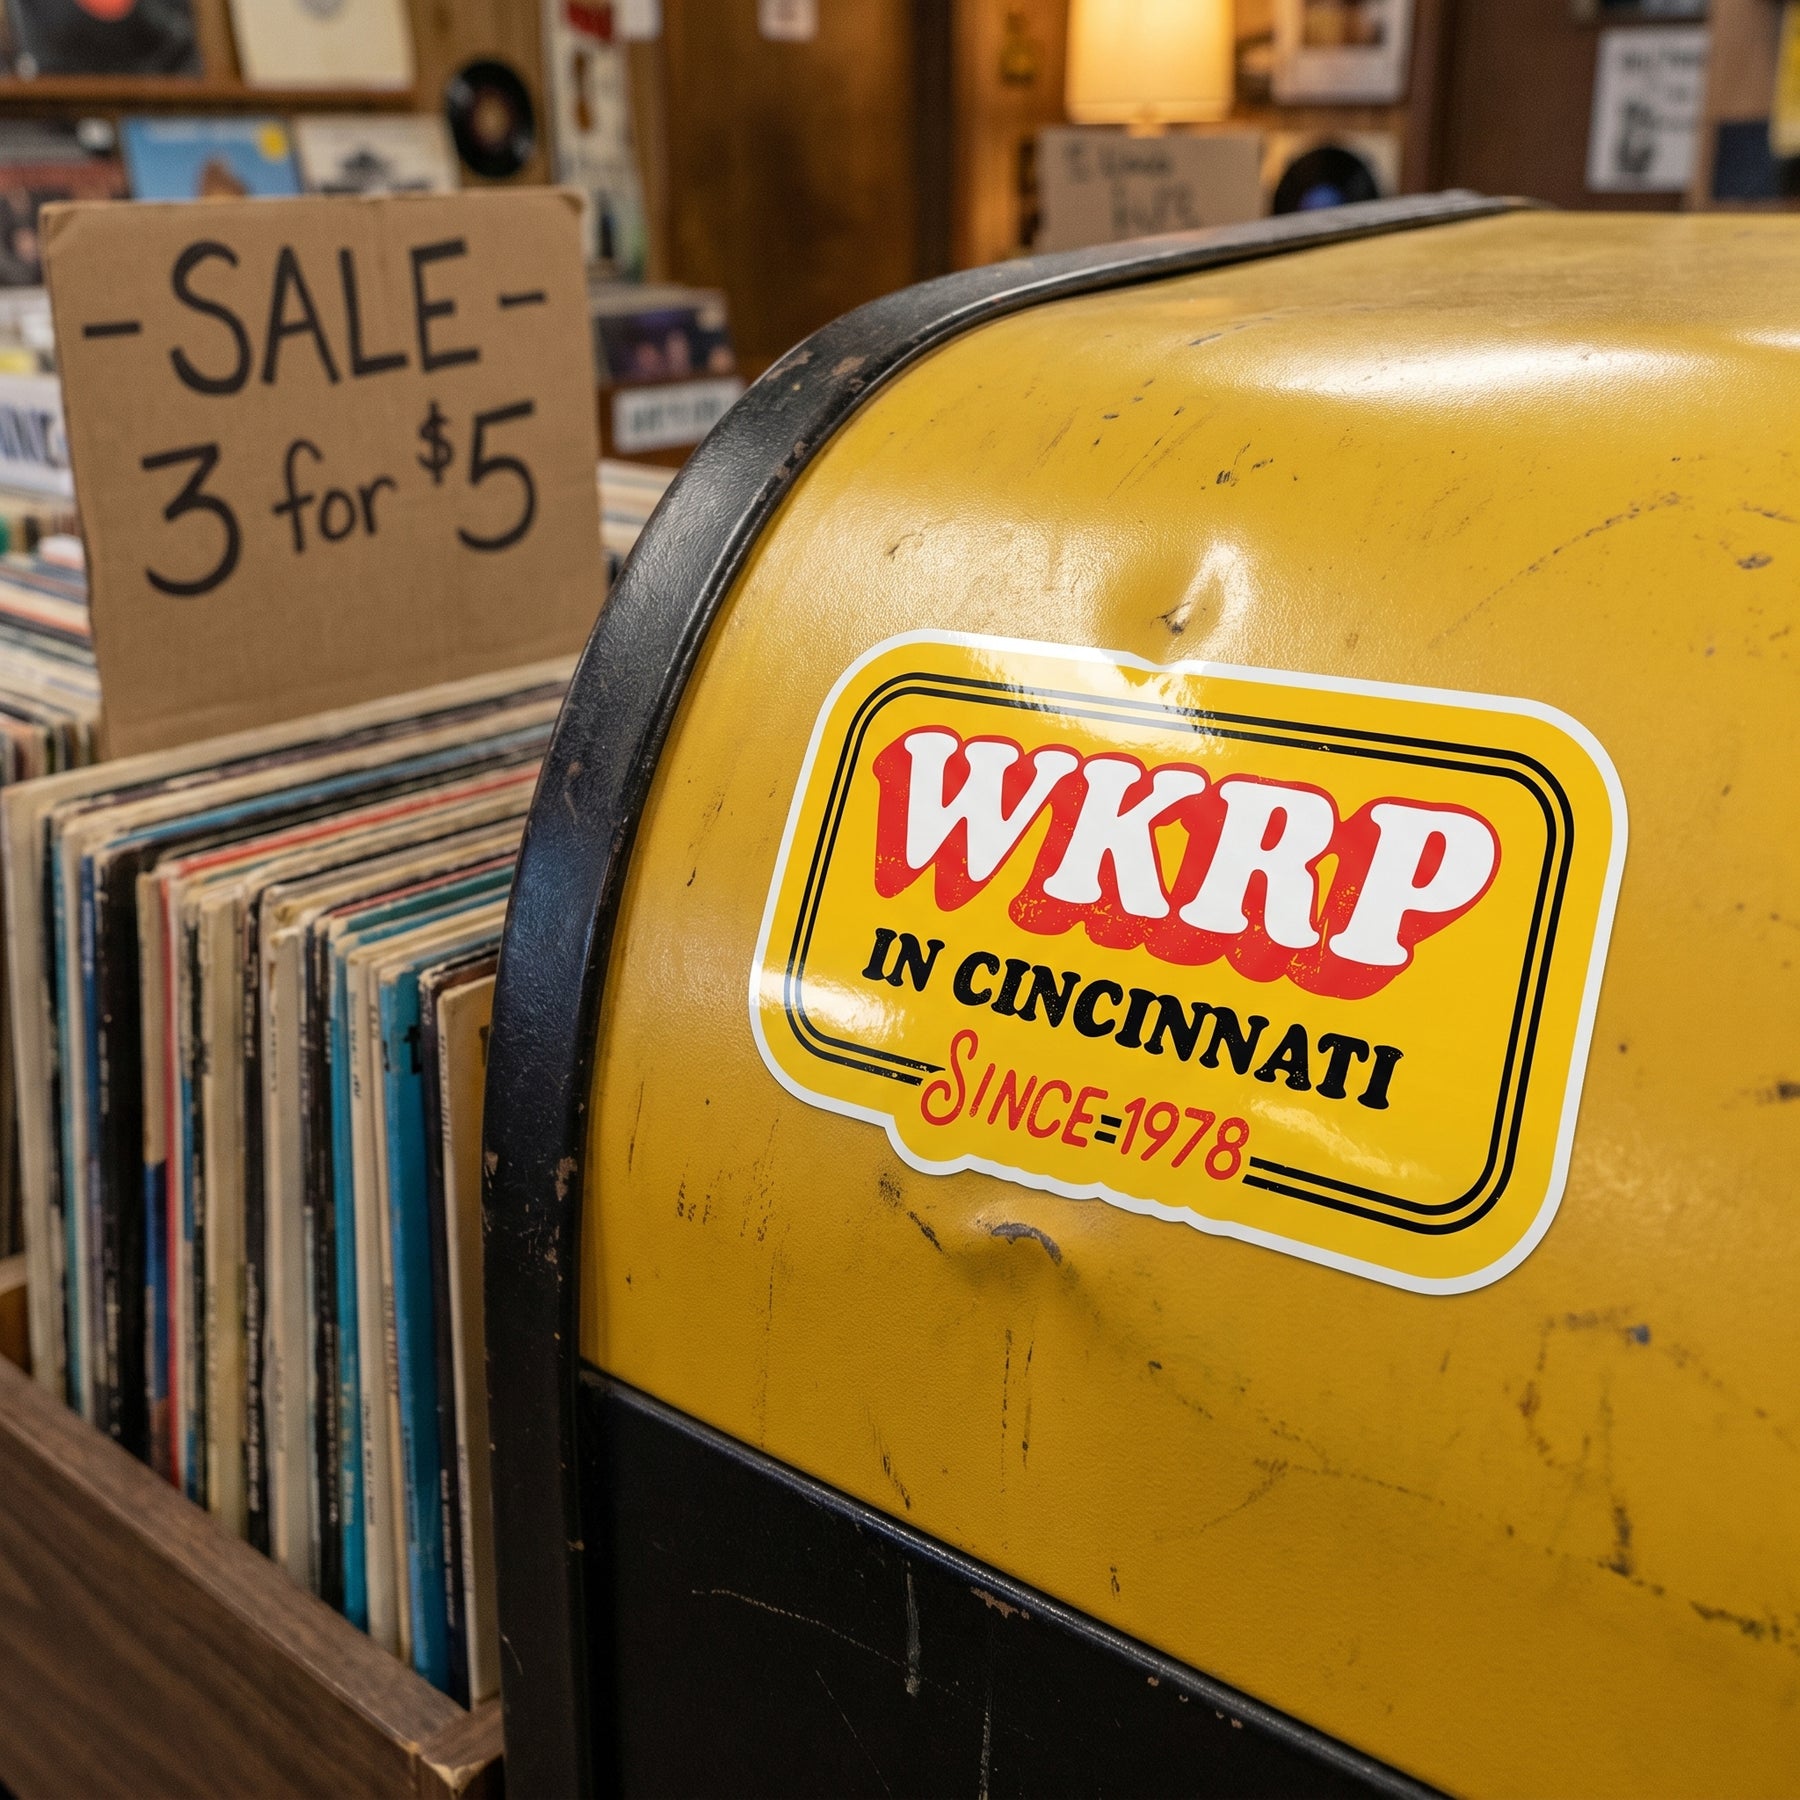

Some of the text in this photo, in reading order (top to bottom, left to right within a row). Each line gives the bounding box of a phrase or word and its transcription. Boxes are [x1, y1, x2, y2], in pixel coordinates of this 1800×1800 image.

[141, 400, 537, 597] 3 for $5
[871, 726, 1502, 999] WKRP
[862, 927, 1404, 1110] IN CINCINNATI
[1120, 1097, 1250, 1181] 1978
